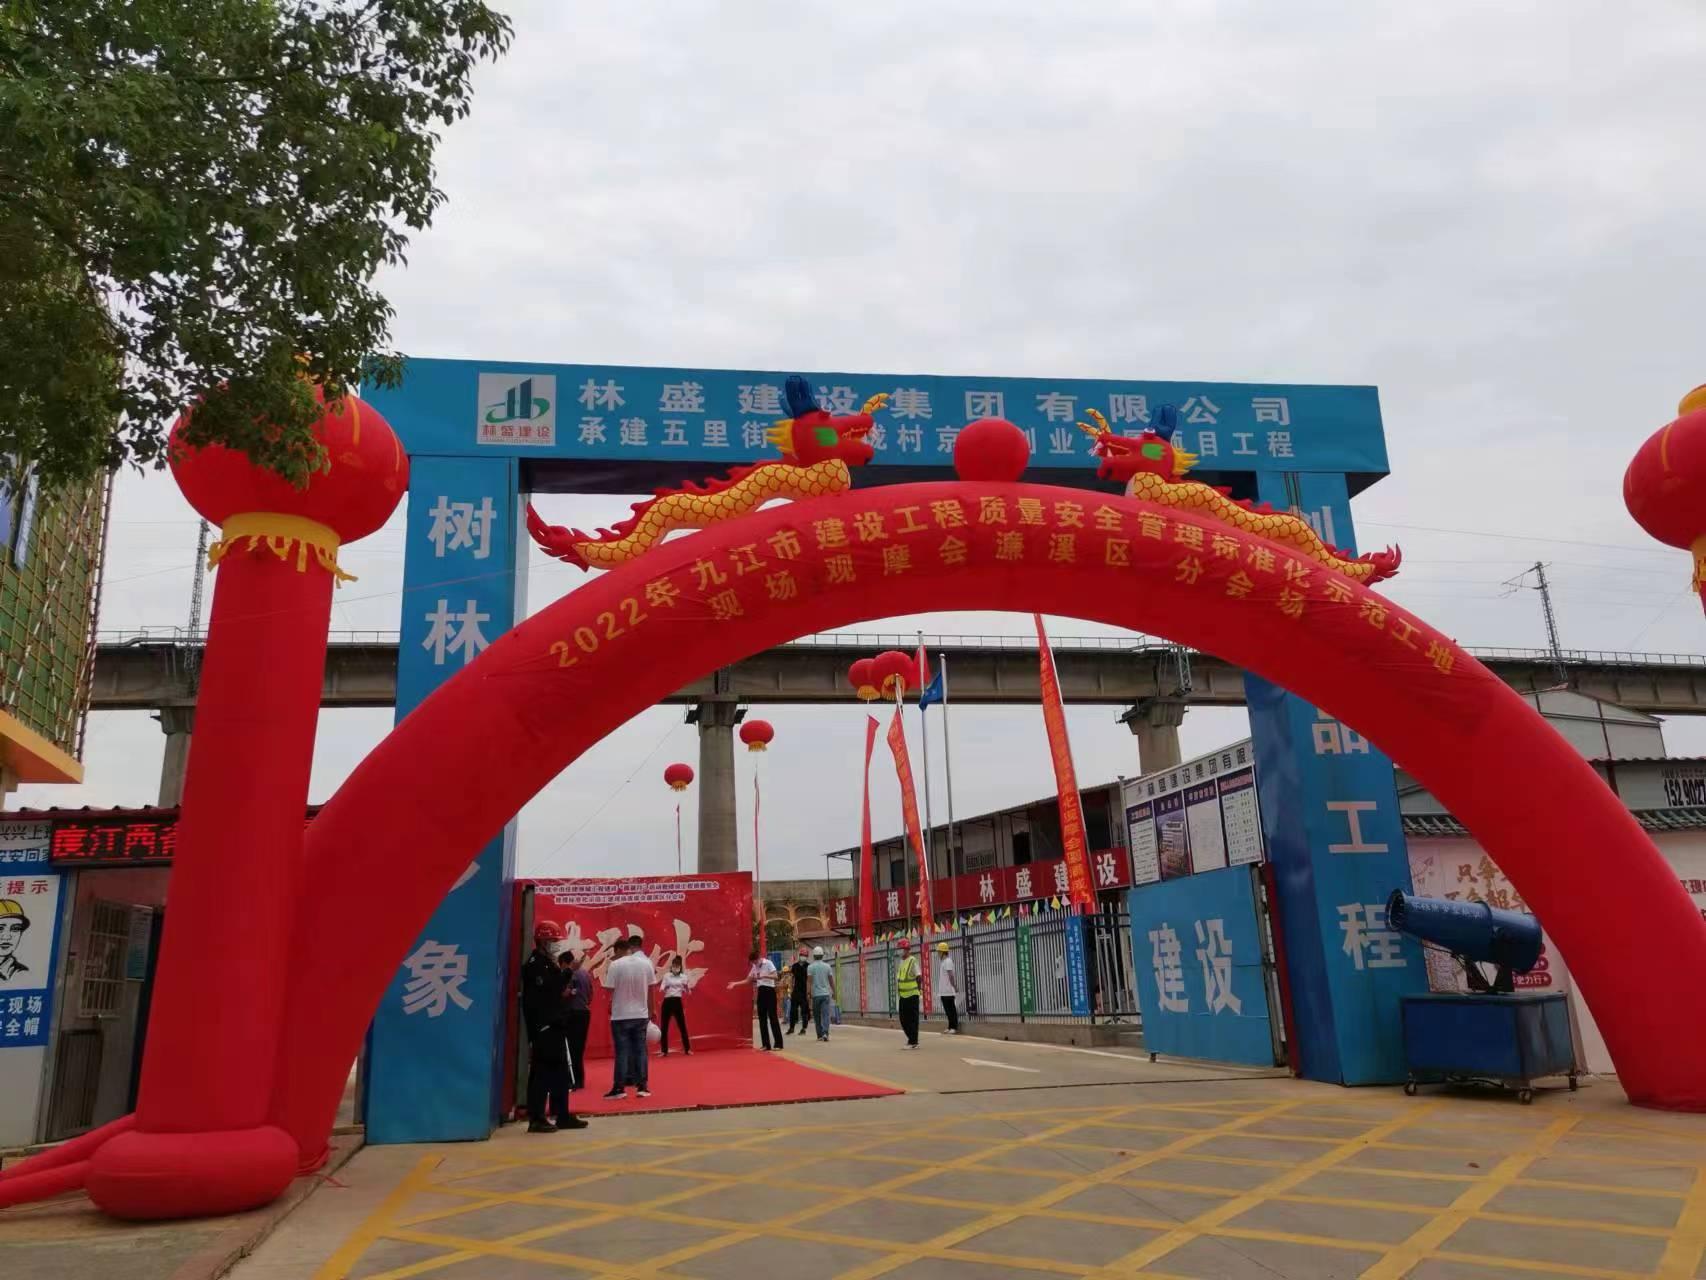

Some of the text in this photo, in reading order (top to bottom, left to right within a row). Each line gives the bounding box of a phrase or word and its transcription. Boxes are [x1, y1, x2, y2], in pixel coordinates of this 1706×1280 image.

[578, 378, 1291, 427] 林盛建设集团有限公司
[0, 880, 49, 896] 提示
[1148, 918, 1242, 1016] 建设
[0, 1017, 41, 1037] 全帽
